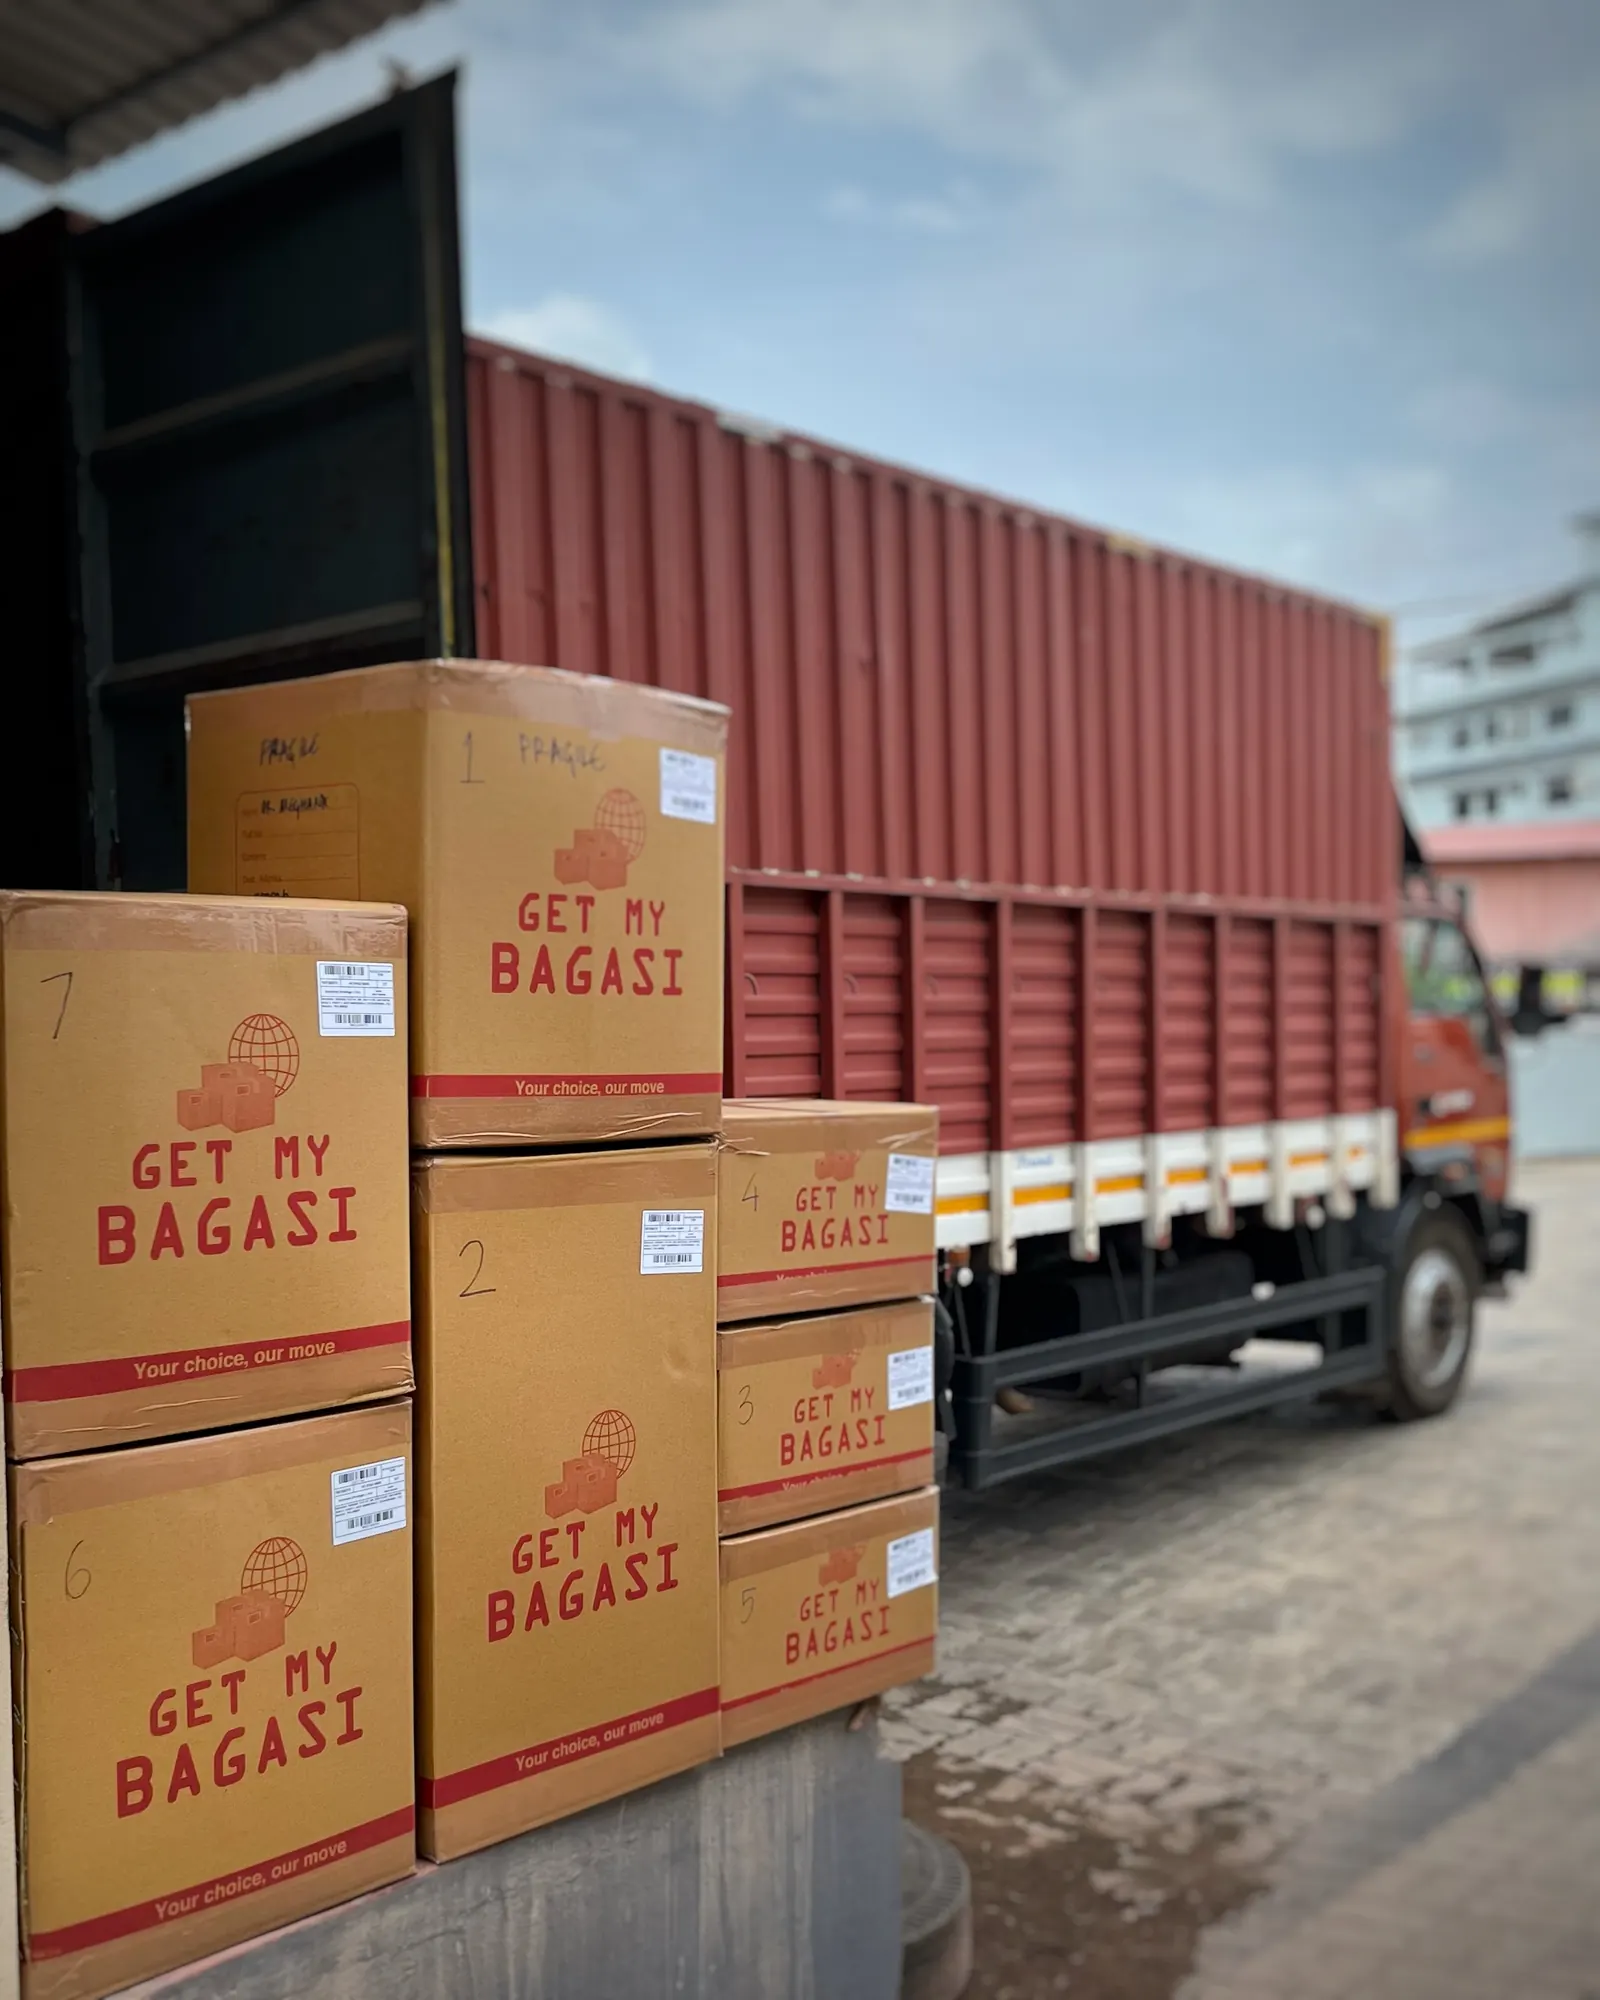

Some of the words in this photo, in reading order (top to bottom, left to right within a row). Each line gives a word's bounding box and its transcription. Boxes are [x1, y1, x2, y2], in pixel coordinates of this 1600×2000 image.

[459, 731, 485, 784] 1
[518, 892, 596, 934] GET
[625, 898, 667, 937] MY
[491, 941, 684, 997] BAGASI
[515, 1080, 550, 1096] Your
[552, 1081, 601, 1097] choice,
[605, 1082, 628, 1095] our
[630, 1081, 665, 1095] move
[132, 1139, 234, 1191] GET
[274, 1133, 331, 1181] MY
[741, 1172, 760, 1213] 4
[796, 1185, 838, 1213] GET
[854, 1184, 879, 1210] MY
[97, 1187, 358, 1267] BAGASI
[781, 1214, 889, 1253] BAGASI
[458, 1239, 497, 1299] 2
[134, 1361, 180, 1380] Your
[184, 1352, 249, 1374] choice,
[254, 1348, 285, 1364] our
[289, 1340, 336, 1360] move
[738, 1384, 755, 1426] 3
[794, 1392, 834, 1424] GET
[851, 1387, 876, 1415] MY
[780, 1414, 886, 1467] BAGASI
[512, 1520, 587, 1576] GET
[615, 1502, 660, 1548] MY
[65, 1539, 93, 1600] 6
[487, 1543, 680, 1643] BAGASI
[740, 1586, 757, 1625] 5
[800, 1588, 840, 1622] GET
[855, 1578, 881, 1607] MY
[785, 1605, 892, 1666] BAGASI
[149, 1669, 247, 1738] GET
[285, 1641, 338, 1698] MY
[116, 1686, 364, 1819] BAGASI
[515, 1750, 550, 1772] Your
[551, 1736, 601, 1760] choice,
[603, 1725, 627, 1742] our
[628, 1712, 665, 1735] move
[154, 1893, 200, 1921] Your
[204, 1871, 267, 1904] choice,
[270, 1858, 300, 1879] our
[302, 1840, 348, 1868] move
